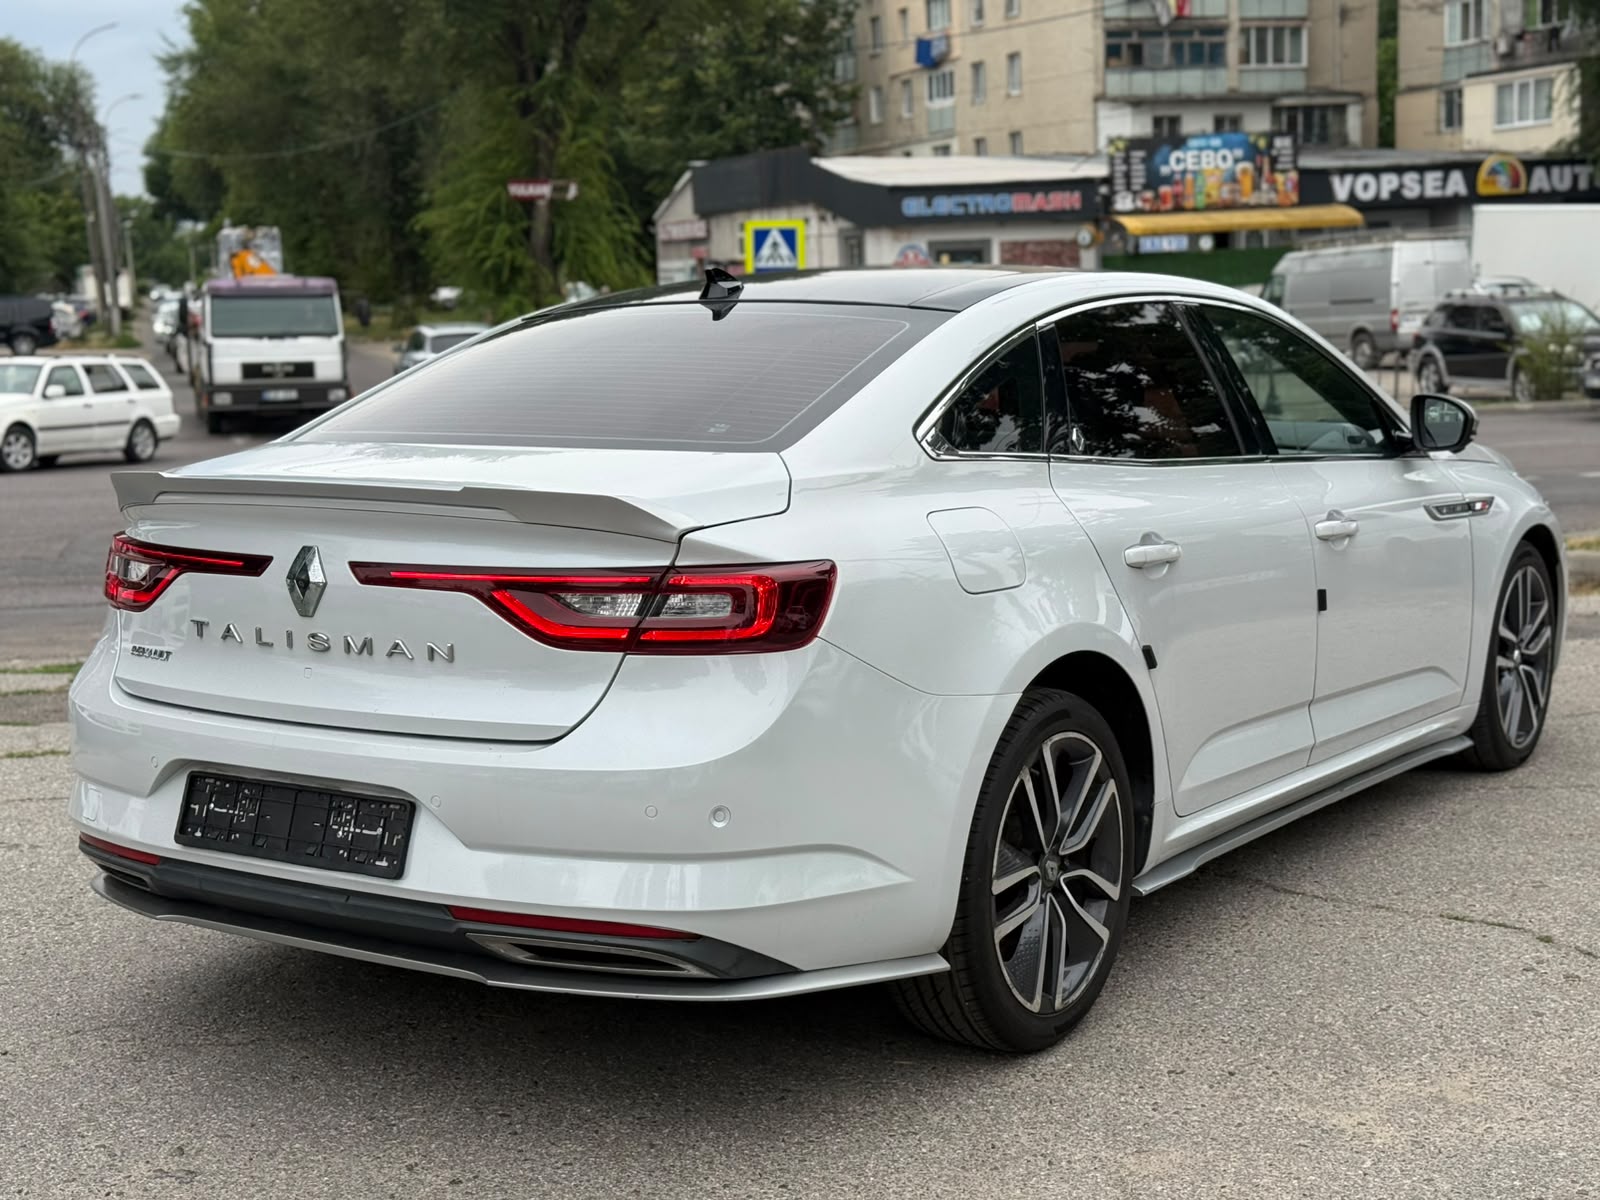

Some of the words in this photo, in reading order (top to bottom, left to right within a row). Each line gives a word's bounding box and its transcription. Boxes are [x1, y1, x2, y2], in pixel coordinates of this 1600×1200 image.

[1330, 168, 1469, 202] VOPSEA
[1528, 164, 1600, 194] AUT
[190, 618, 455, 664] TALISMAN
